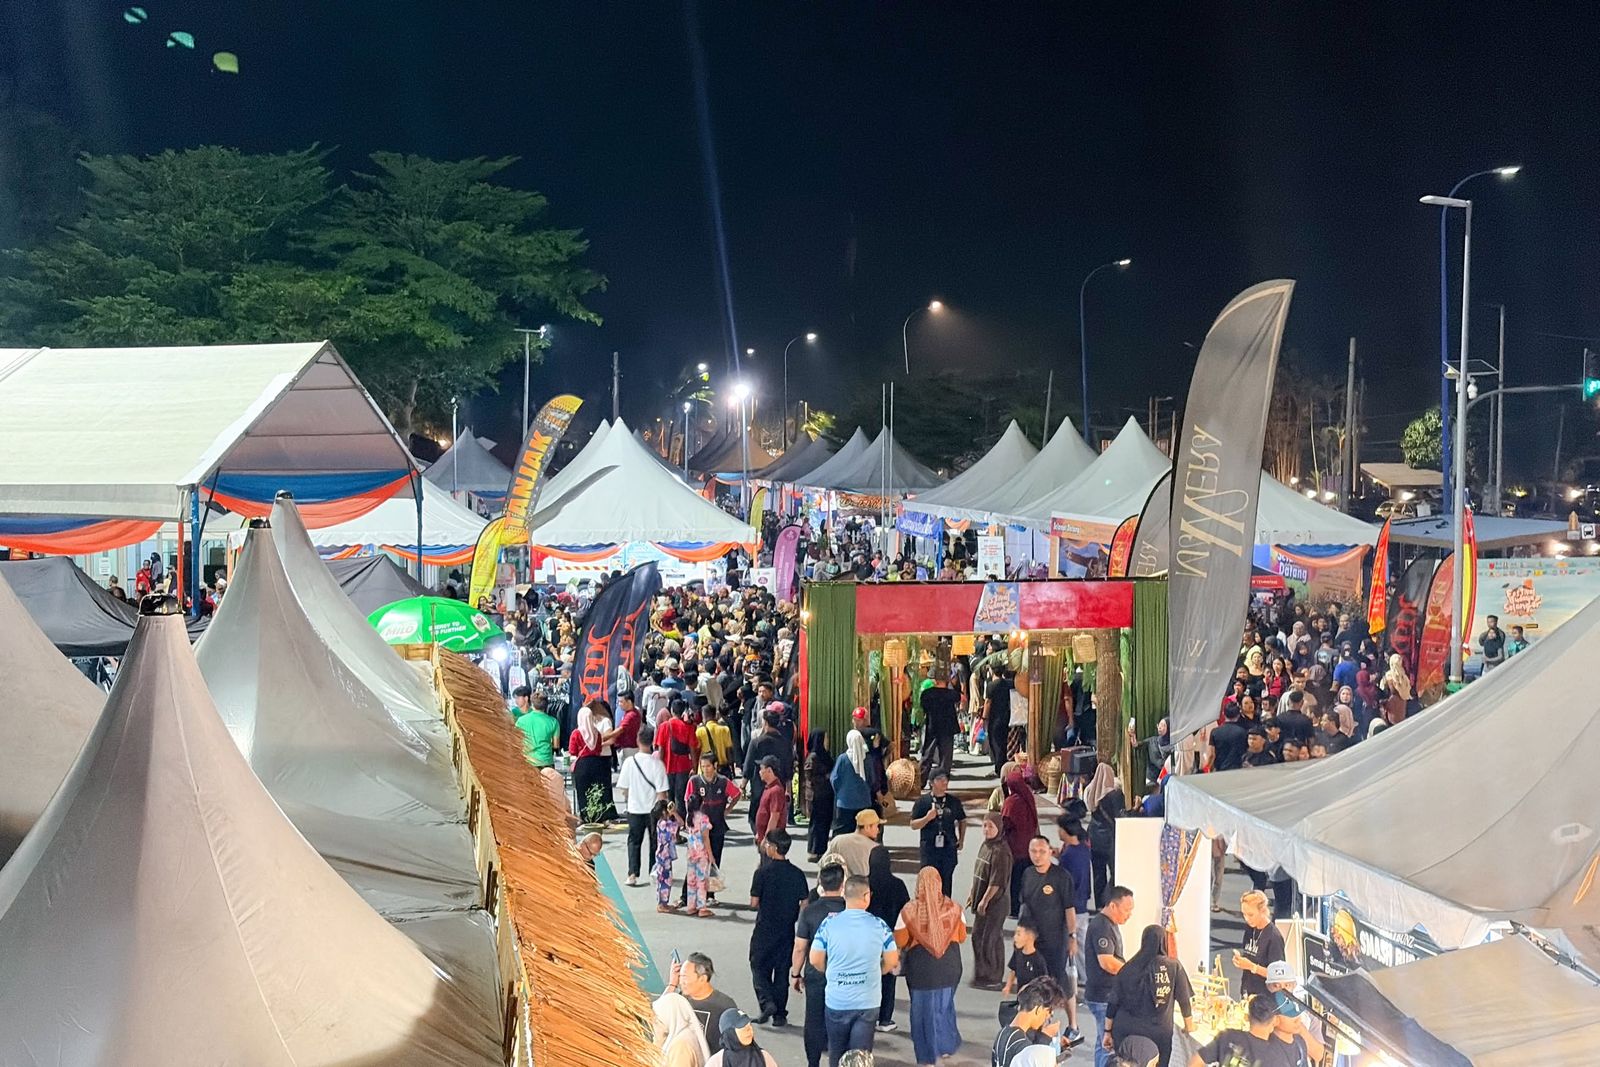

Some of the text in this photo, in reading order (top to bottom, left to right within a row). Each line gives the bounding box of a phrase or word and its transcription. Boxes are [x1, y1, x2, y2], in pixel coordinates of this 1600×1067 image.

[504, 429, 553, 529] TANJAK
[1279, 562, 1308, 585] Datang
[385, 625, 414, 637] MILO
[1360, 930, 1393, 967] SMASH
